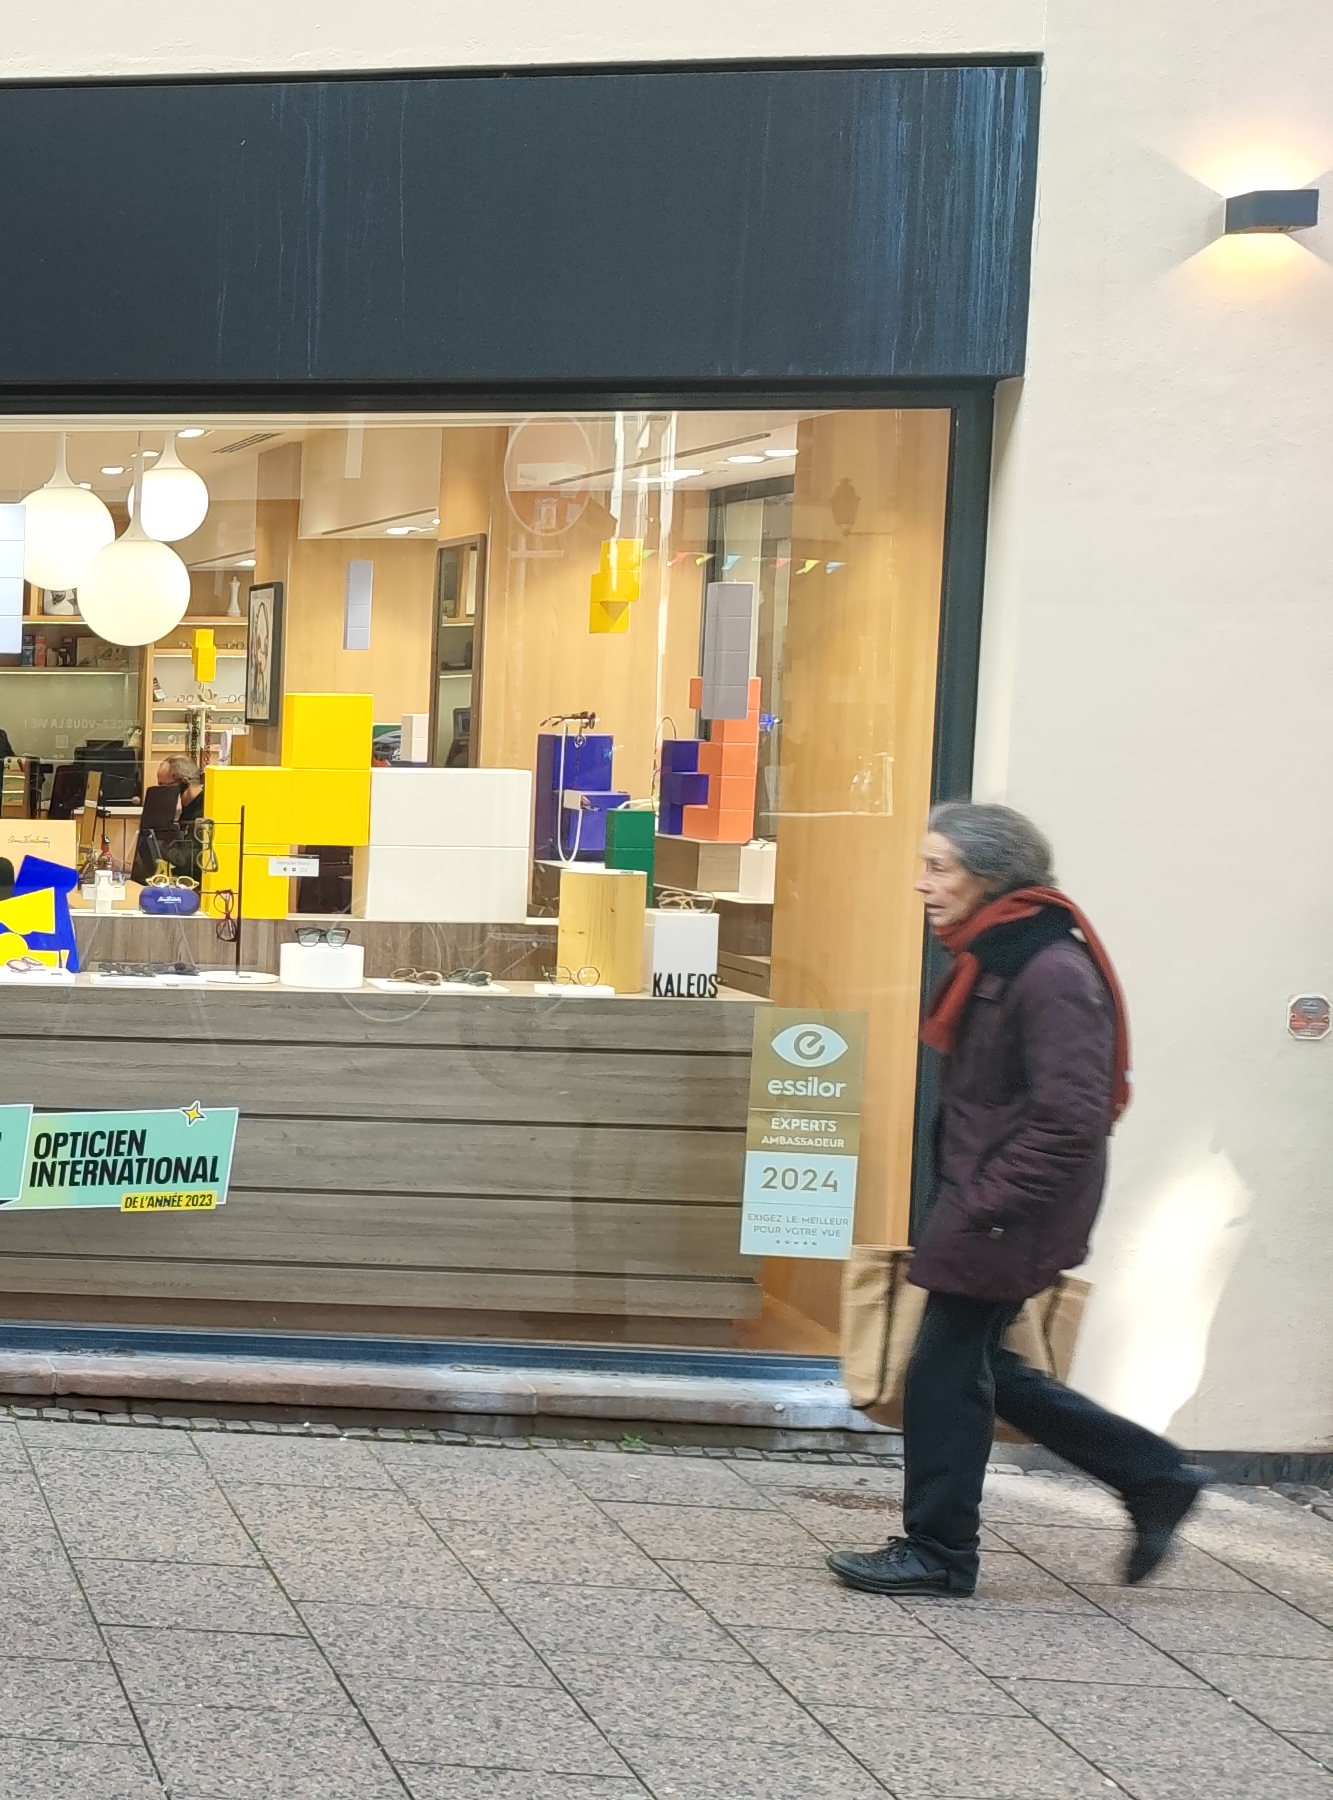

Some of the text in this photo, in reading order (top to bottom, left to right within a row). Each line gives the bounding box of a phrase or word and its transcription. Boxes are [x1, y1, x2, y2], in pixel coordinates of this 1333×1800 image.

[652, 972, 718, 998] KALEOS
[767, 1076, 848, 1098] essilor
[770, 1116, 838, 1133] EXPERTS
[34, 1128, 148, 1160] OPTICIEN
[760, 1135, 845, 1148] AMBASSADEUR
[29, 1155, 220, 1188] INTERNATIONAL
[760, 1166, 838, 1193] 2024
[124, 1192, 213, 1209] DE L'ANNÉE 2023
[747, 1213, 849, 1226] EXIGEZ LE MEILLEUR
[753, 1225, 841, 1238] POUR VOTRE VUE
